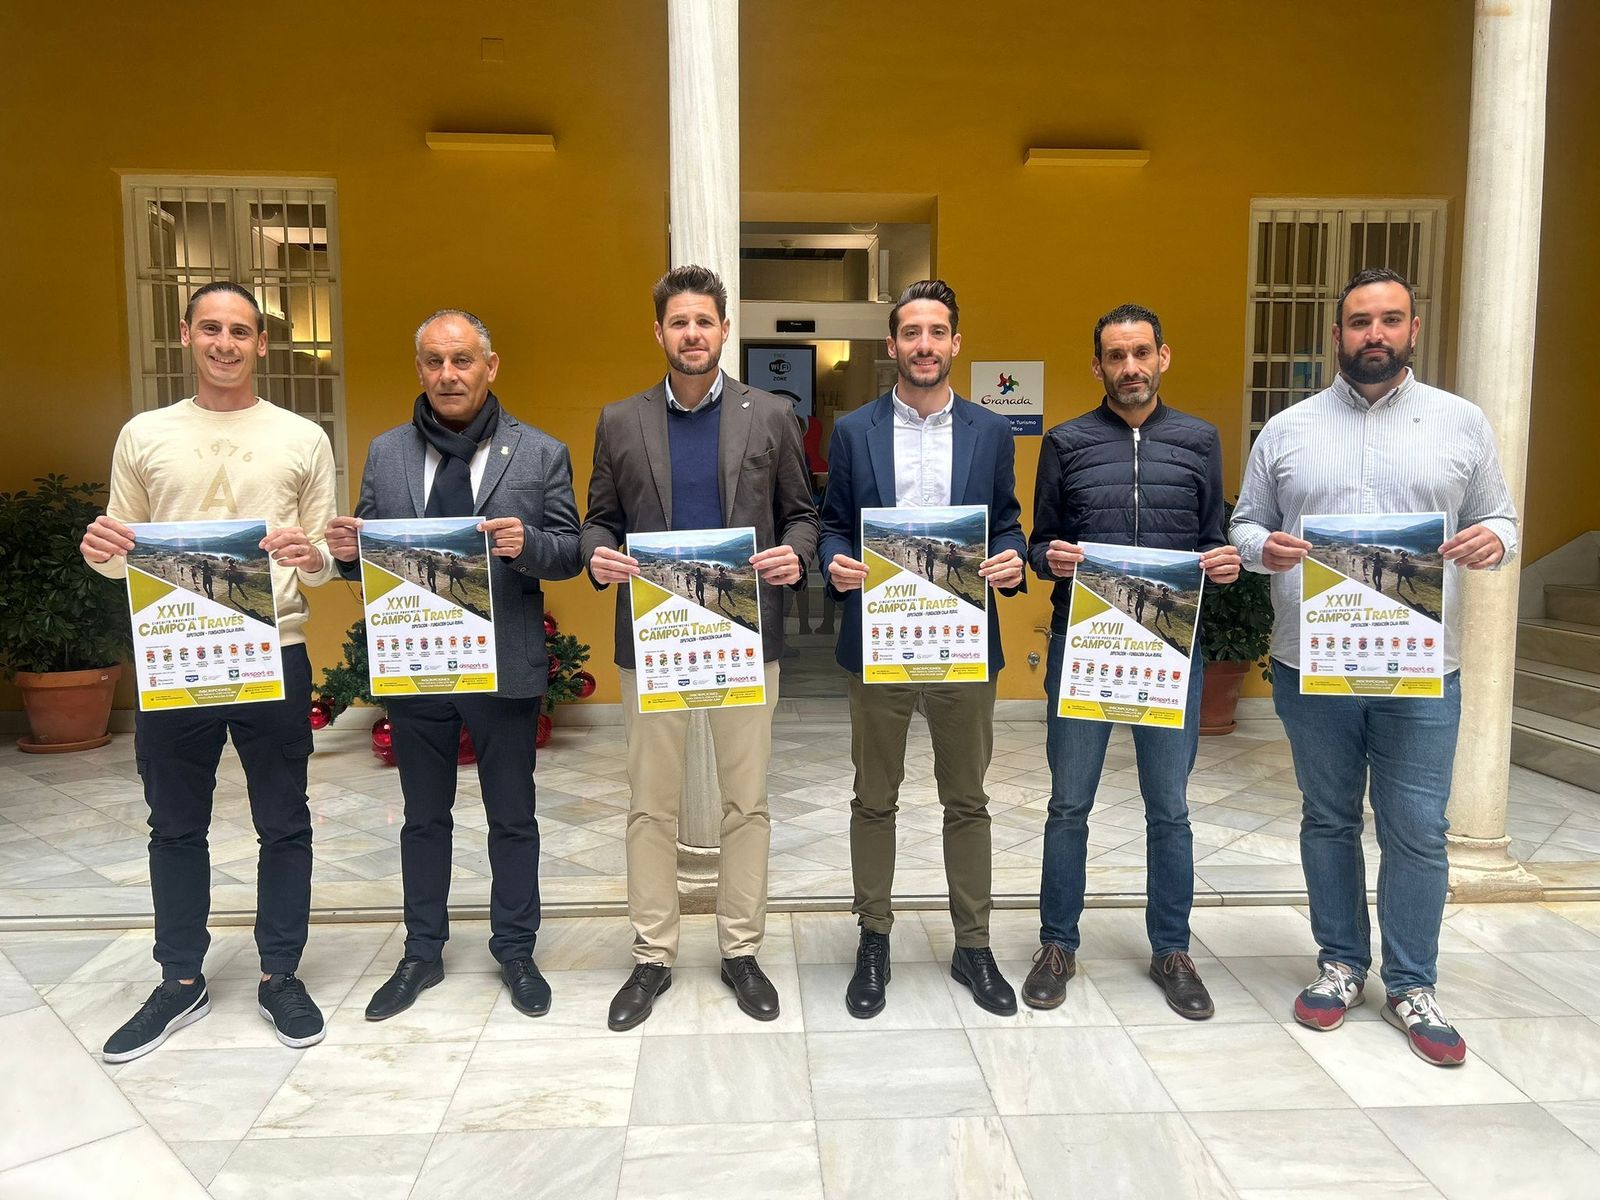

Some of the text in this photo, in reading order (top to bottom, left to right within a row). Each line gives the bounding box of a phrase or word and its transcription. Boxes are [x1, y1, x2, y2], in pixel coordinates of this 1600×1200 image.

[981, 395, 1032, 405] Granada
[194, 444, 253, 462] 1976
[199, 464, 237, 513] A
[884, 584, 916, 598] XXVII
[387, 595, 419, 610] XXVII
[868, 596, 958, 614] CAMPO A TRAVÉS
[1325, 594, 1361, 607] XXVII
[157, 603, 194, 619] XXVII
[371, 607, 463, 626] CAMPO A TRAVÉS
[655, 609, 687, 625] XXVII
[1307, 607, 1409, 623] CAMPO A TRAVÉS
[139, 613, 244, 636] CAMPO A TRAVÉS
[639, 620, 731, 641] CAMPO A TRAVÉS
[1089, 622, 1123, 635] XXVII
[1072, 636, 1163, 651] CAMPO A TRAVÉS
